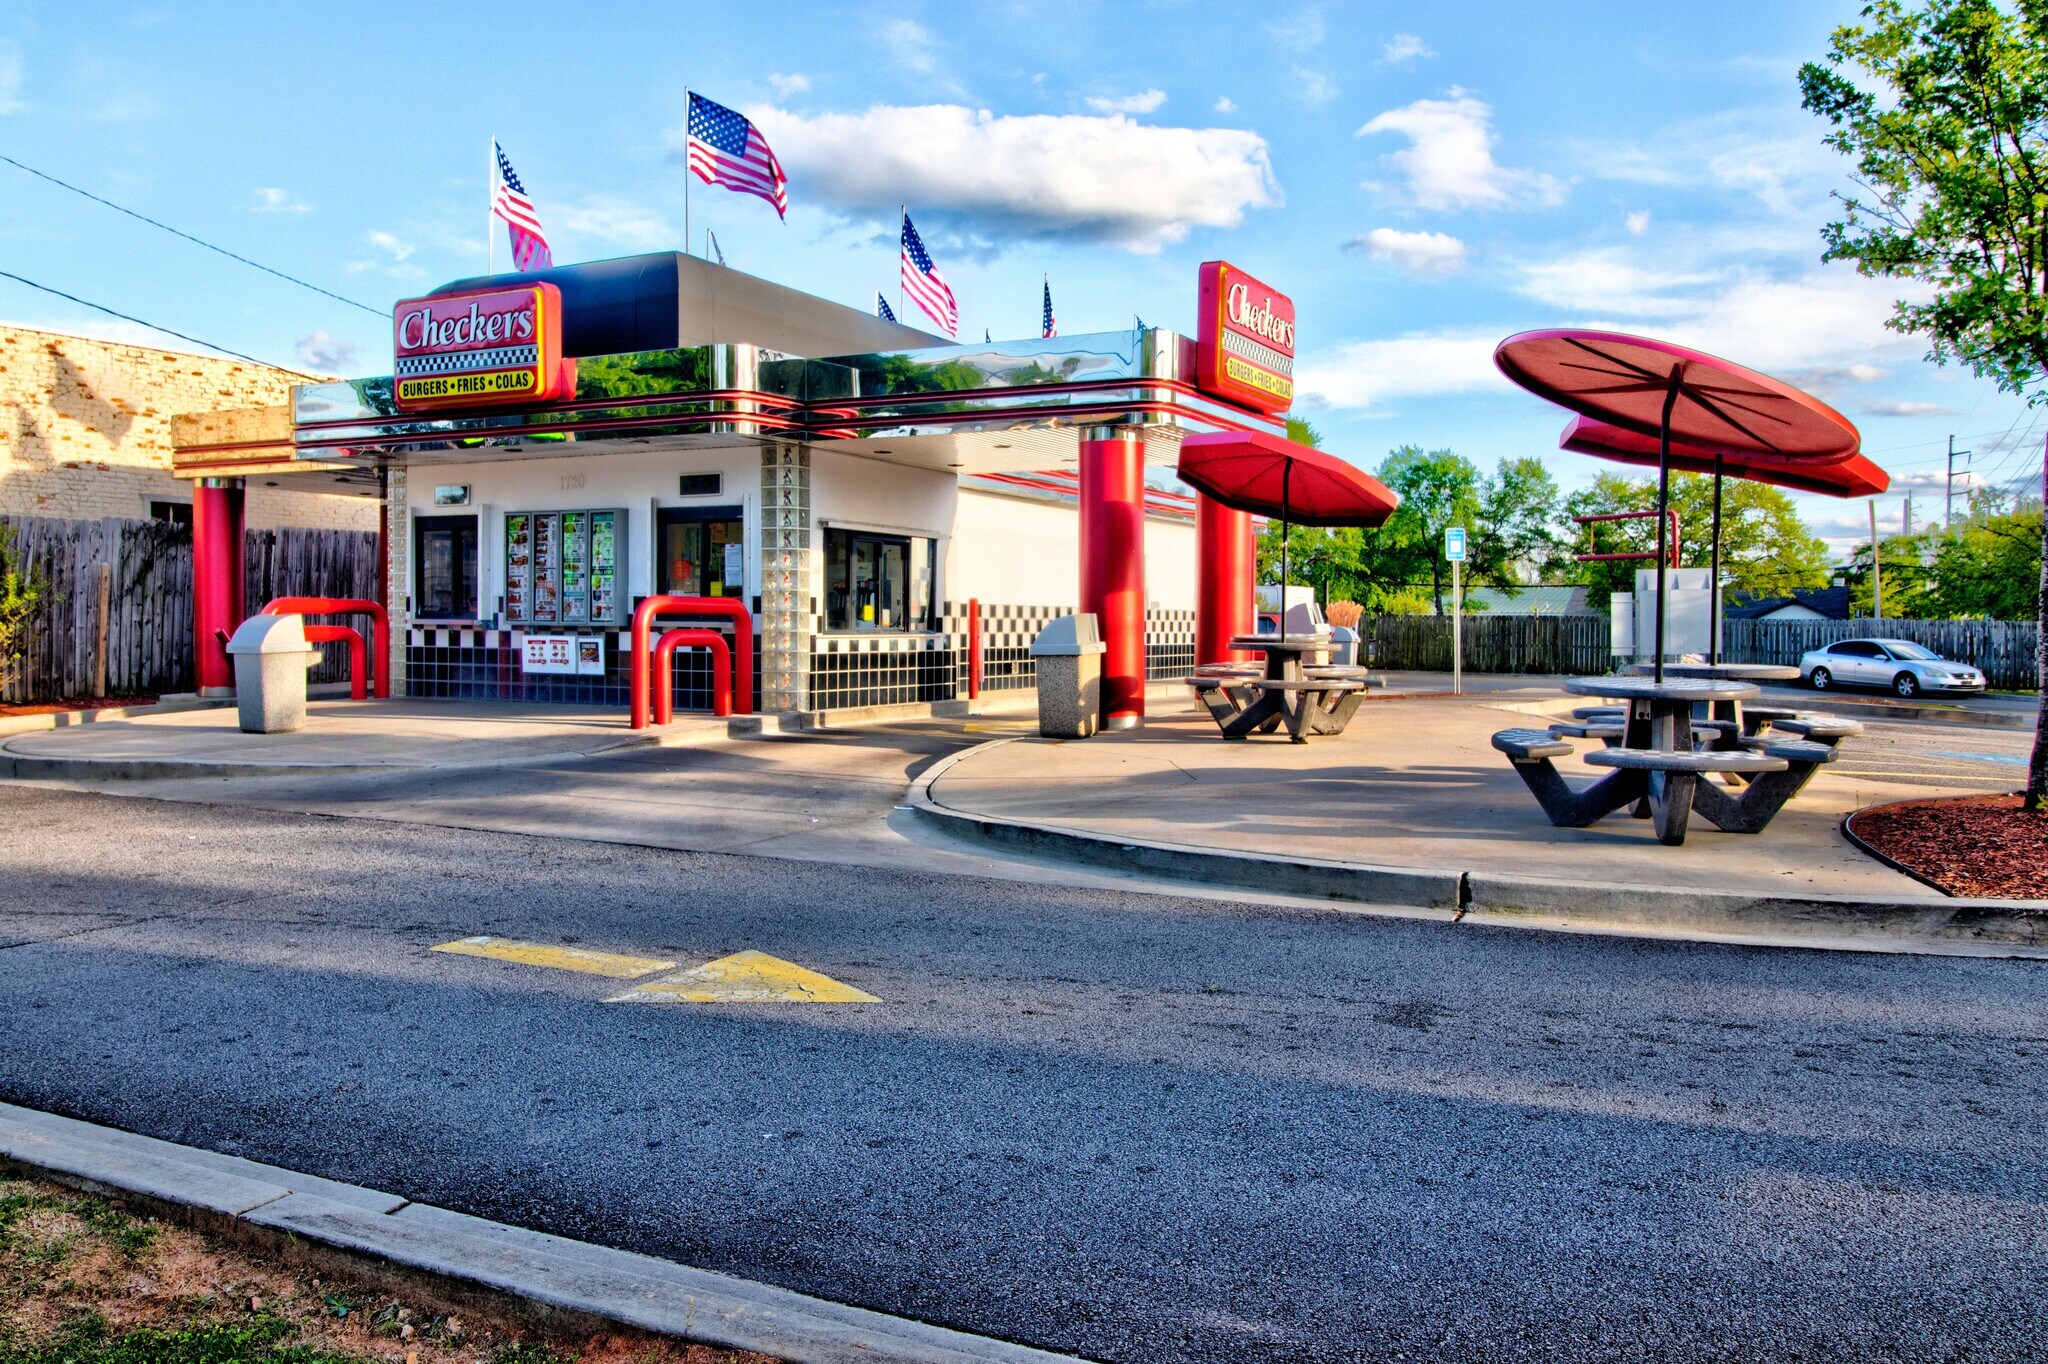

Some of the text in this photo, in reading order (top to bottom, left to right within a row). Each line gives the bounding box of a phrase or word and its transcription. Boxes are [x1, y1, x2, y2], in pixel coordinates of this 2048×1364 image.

[400, 302, 533, 349] Checkers
[1228, 283, 1294, 349] Checkers
[403, 372, 529, 397] BURGERS FRIES COLAS
[1229, 360, 1291, 397] BURGERS FRIES COLAS
